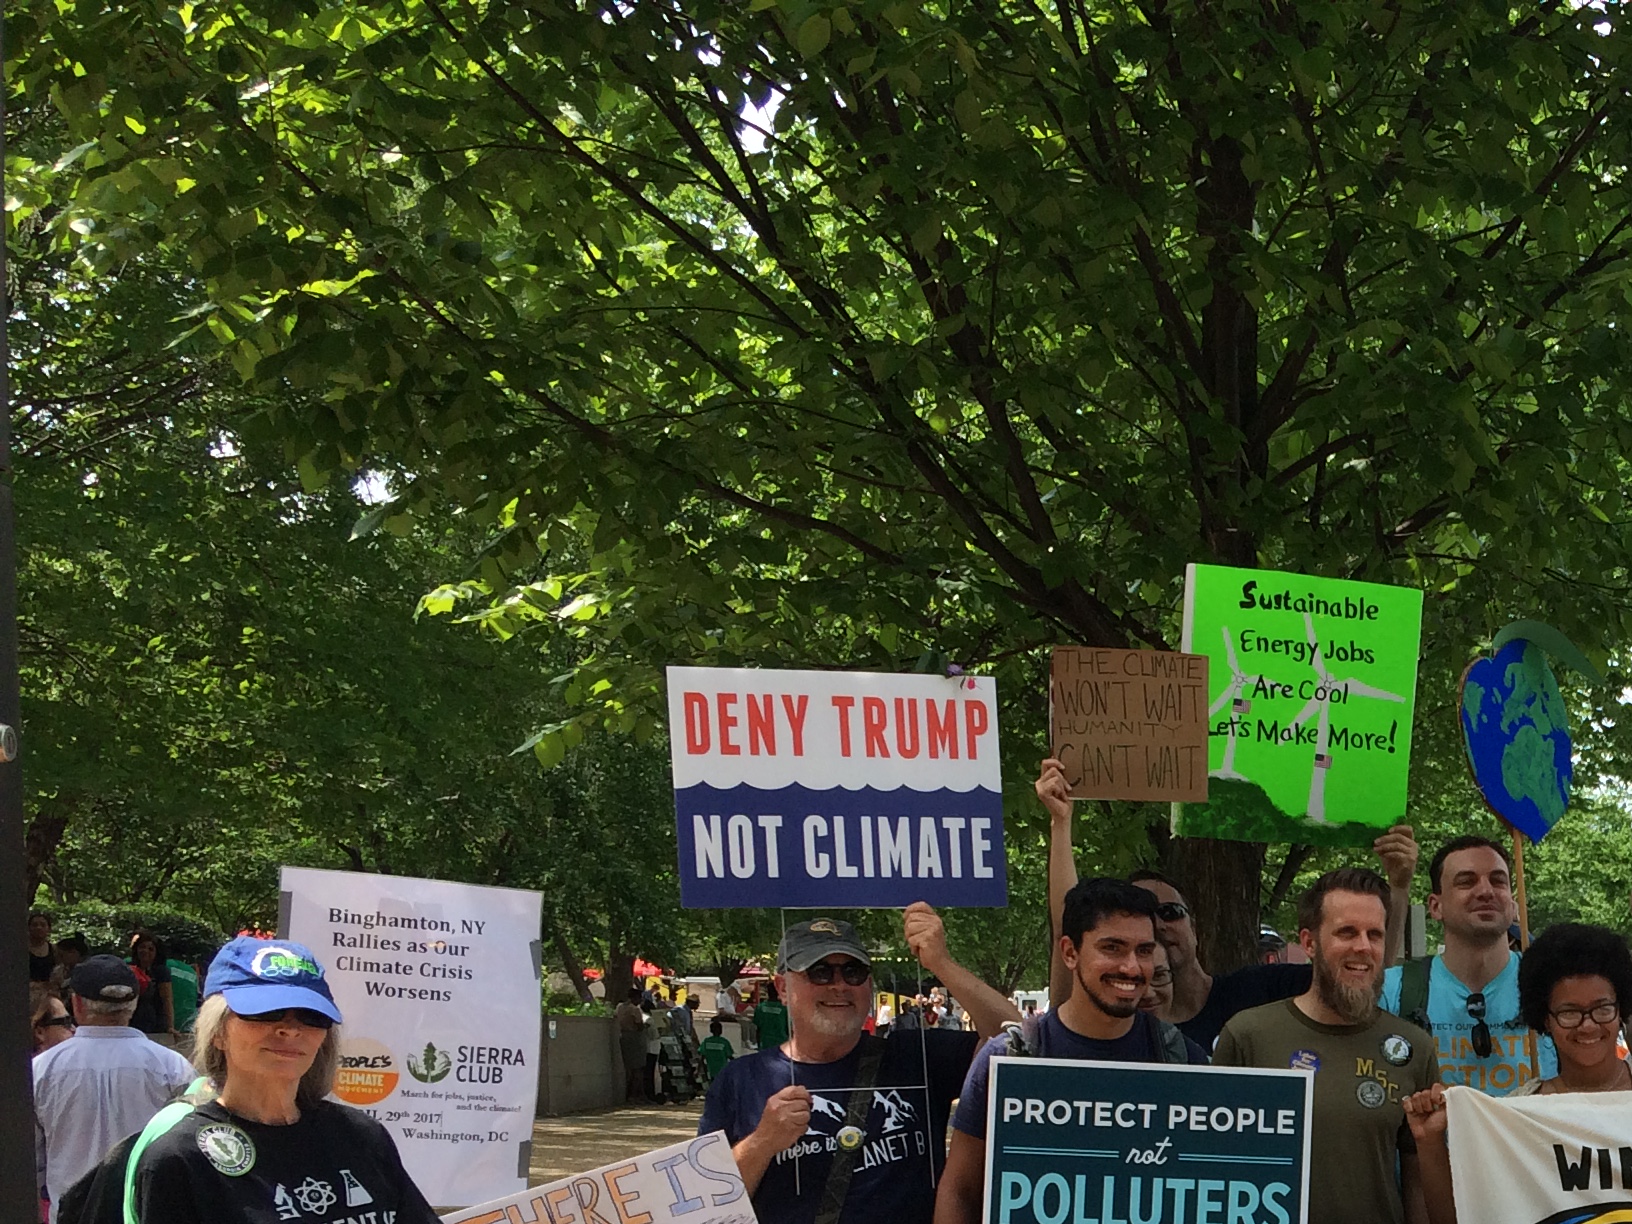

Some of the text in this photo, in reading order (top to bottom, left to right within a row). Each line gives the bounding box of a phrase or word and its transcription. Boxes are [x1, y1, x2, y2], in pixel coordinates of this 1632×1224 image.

[1239, 581, 1379, 621] Sustainable
[1241, 630, 1375, 666] Energy Jobs
[1057, 651, 1202, 680] THE CLIMATE
[1060, 679, 1202, 722] WON'T WAIT
[1252, 674, 1349, 704] Are Cool
[683, 692, 988, 760] DENY TRUMP
[1058, 719, 1183, 738] HUMANITY
[1257, 719, 1318, 745] Make
[1328, 719, 1397, 753] More!
[1057, 744, 1200, 790] CAN'T WAIT
[693, 815, 994, 878] NOT CLIMATE
[329, 908, 486, 935] Binghamton, NY
[332, 932, 469, 957] Rallies as Our
[336, 956, 413, 976] Climate
[419, 962, 473, 980] Crisis
[365, 981, 452, 1001] Worsens
[457, 1045, 525, 1066] SIERRA
[1434, 1035, 1530, 1059] LIMATE
[339, 1072, 384, 1086] CLIMATE
[456, 1066, 503, 1084] CLUB
[1439, 1063, 1532, 1089] CTION
[401, 1089, 497, 1102] March for jobs, justice,
[386, 1110, 410, 1122] 29th
[413, 1113, 440, 1124] 2017
[489, 1105, 521, 1113] climate!
[1003, 1097, 1296, 1134] PROTECT PEOPLE
[402, 1127, 509, 1143] Washington, DC
[915, 1130, 926, 1155] B
[1125, 1136, 1172, 1165] not
[653, 1136, 746, 1217] IS
